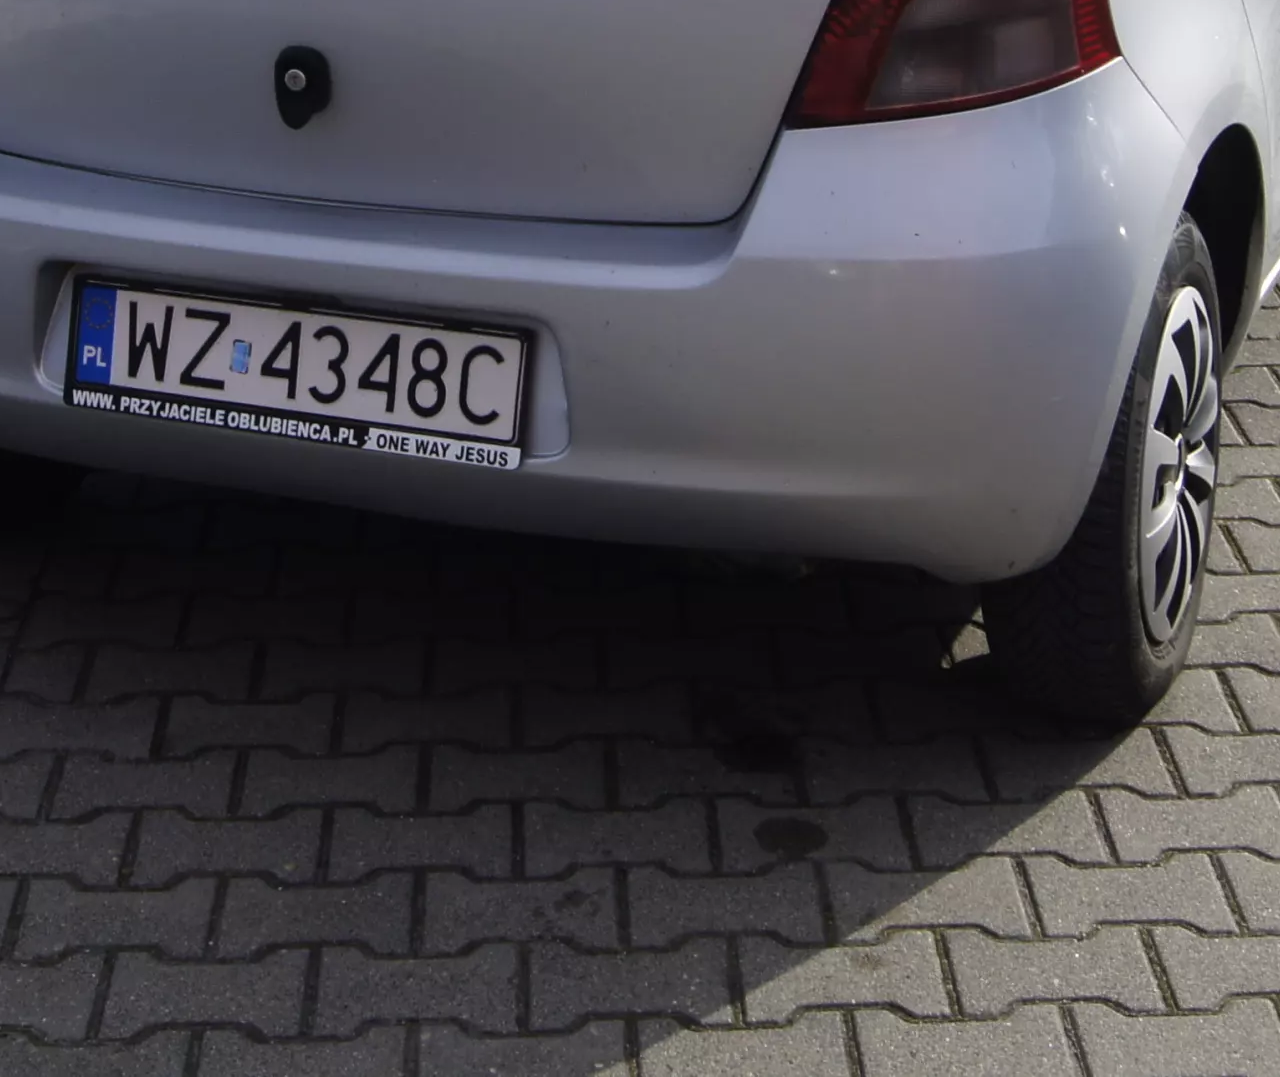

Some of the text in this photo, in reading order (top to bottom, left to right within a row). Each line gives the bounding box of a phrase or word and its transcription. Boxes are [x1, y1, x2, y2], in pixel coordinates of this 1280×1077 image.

[82, 300, 506, 426] PL WZ 4348C
[72, 388, 509, 468] WWW. PRZYJACIELE OBLUBIENCA.PL ONE WAY JESUS
